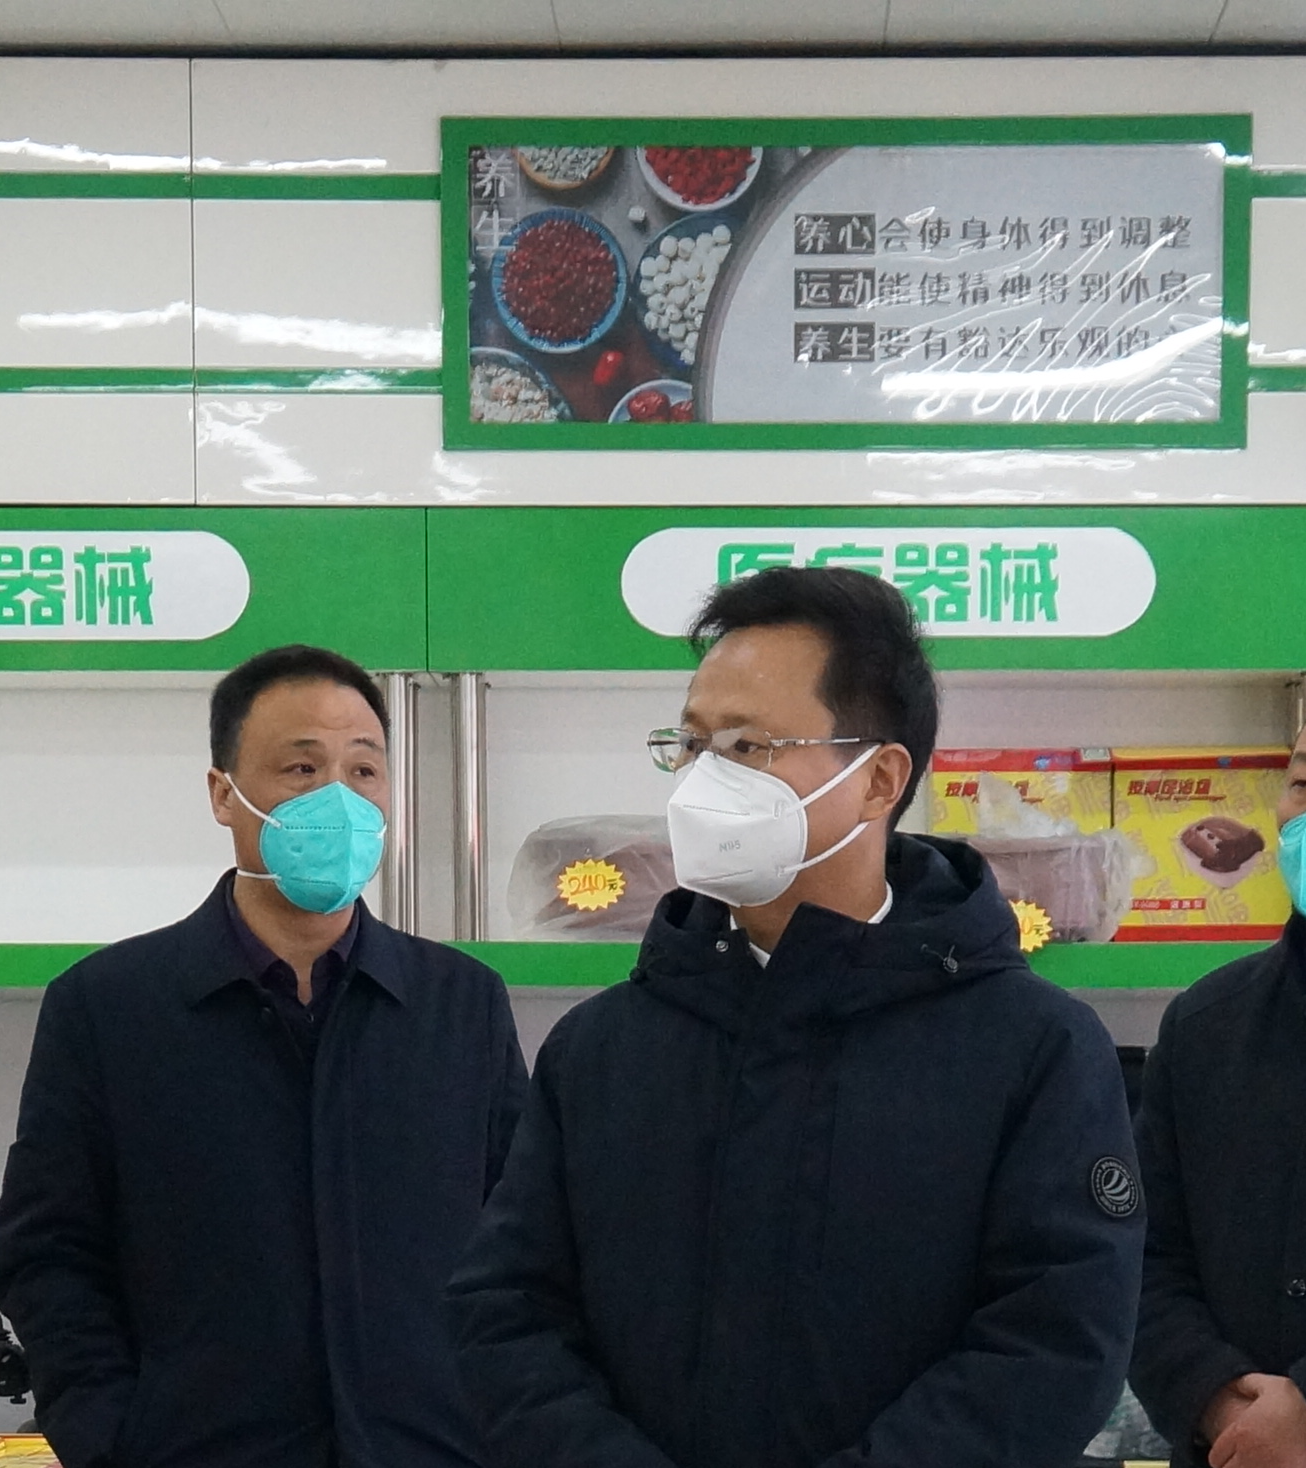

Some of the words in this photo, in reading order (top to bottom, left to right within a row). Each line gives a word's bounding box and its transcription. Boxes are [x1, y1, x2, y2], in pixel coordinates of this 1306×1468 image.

[795, 214, 1191, 252] 养心会使身体得到调整
[795, 270, 1190, 308] 运动能使精神得到休息
